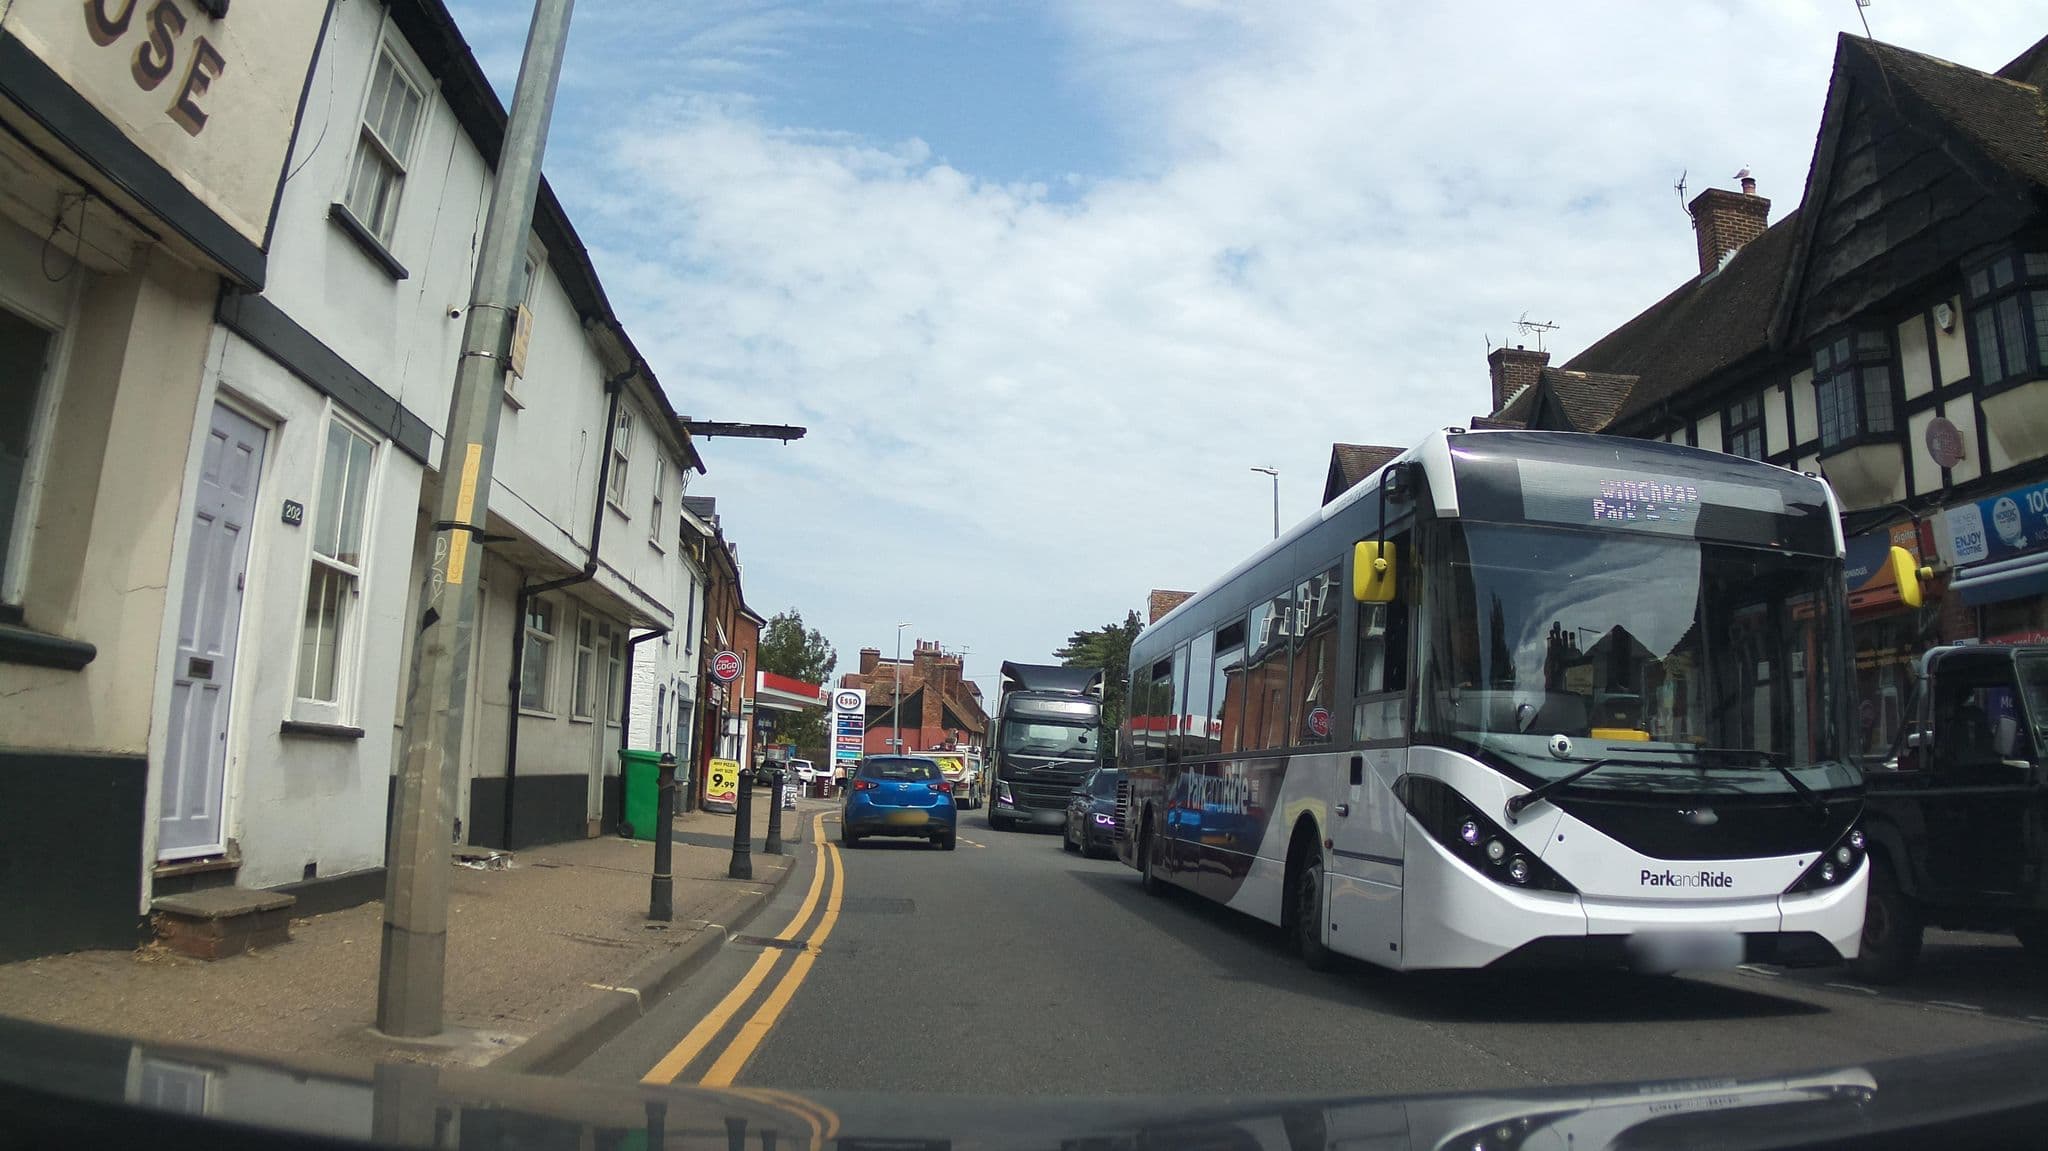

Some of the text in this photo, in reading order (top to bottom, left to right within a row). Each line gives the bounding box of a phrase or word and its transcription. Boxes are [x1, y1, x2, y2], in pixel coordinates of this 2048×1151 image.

[286, 504, 301, 521] 202
[1955, 531, 1981, 549] ENJOY
[712, 773, 735, 789] 9.99
[1640, 869, 1733, 888] ParkandRide
